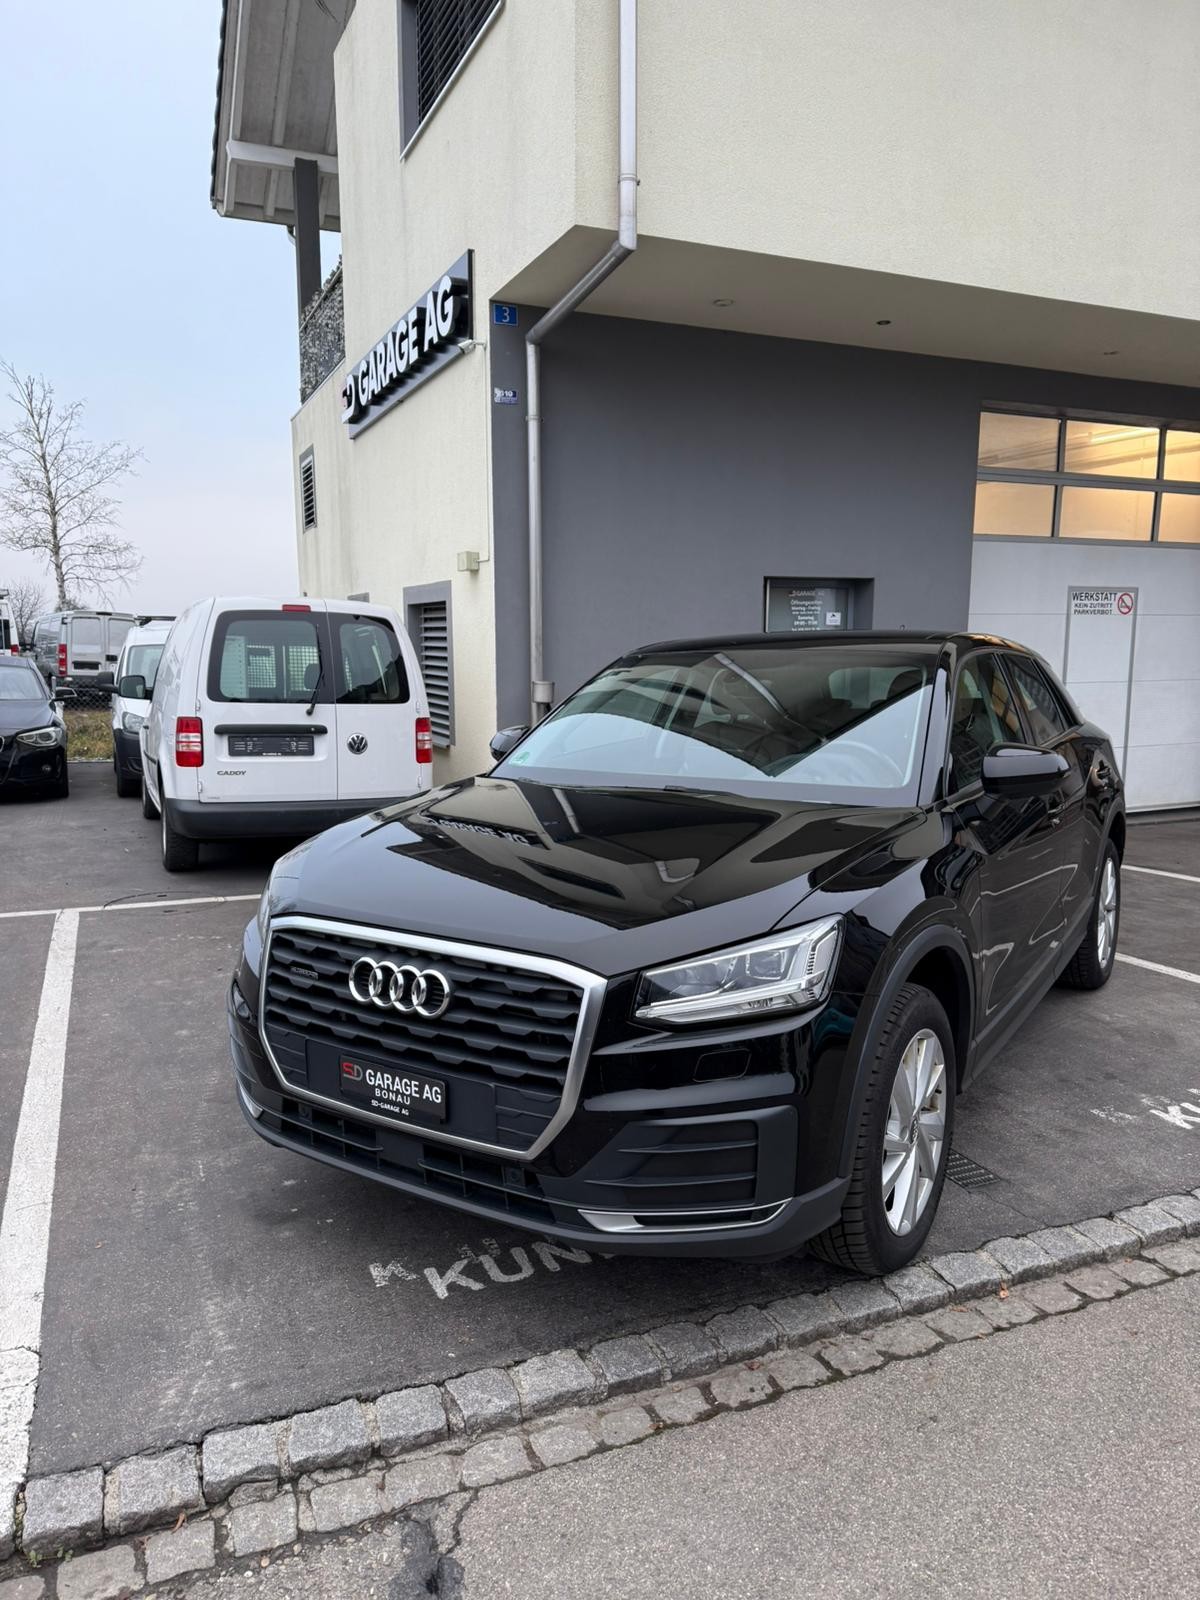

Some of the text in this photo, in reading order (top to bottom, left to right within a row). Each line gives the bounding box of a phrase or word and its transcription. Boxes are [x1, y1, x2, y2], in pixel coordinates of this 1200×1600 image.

[502, 307, 510, 322] 3
[358, 307, 419, 406] GARAGE
[424, 275, 454, 352] AG
[1072, 592, 1117, 602] WERKSTATT
[342, 1062, 442, 1103] SD GARAGE AG
[375, 1088, 410, 1105] BONAU
[371, 1099, 400, 1113] SD-GARAGE
[423, 1240, 614, 1299] KUN
